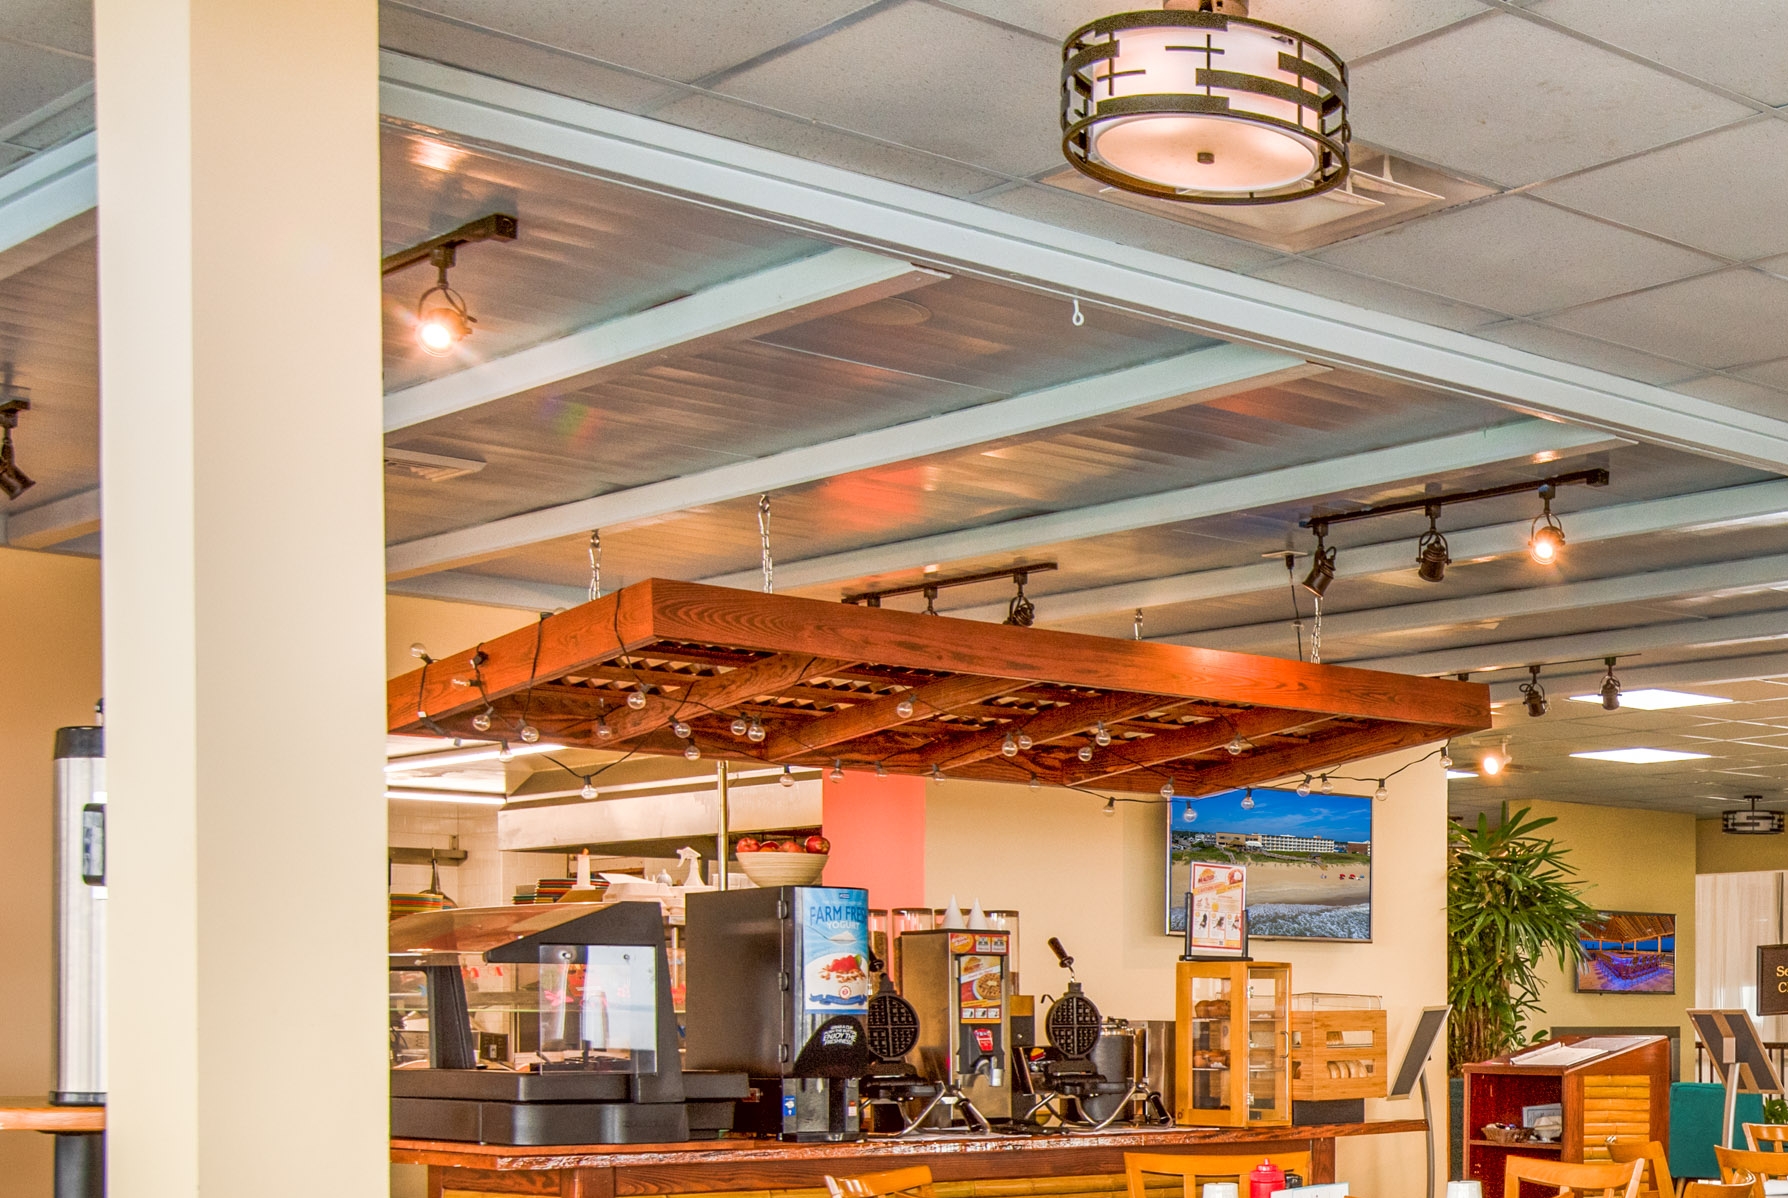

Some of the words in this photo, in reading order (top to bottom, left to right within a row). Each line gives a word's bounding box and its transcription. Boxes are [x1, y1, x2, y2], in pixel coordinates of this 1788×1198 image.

[810, 905, 842, 926] FARM
[846, 906, 867, 924] FRES
[827, 921, 860, 930] YOGURT
